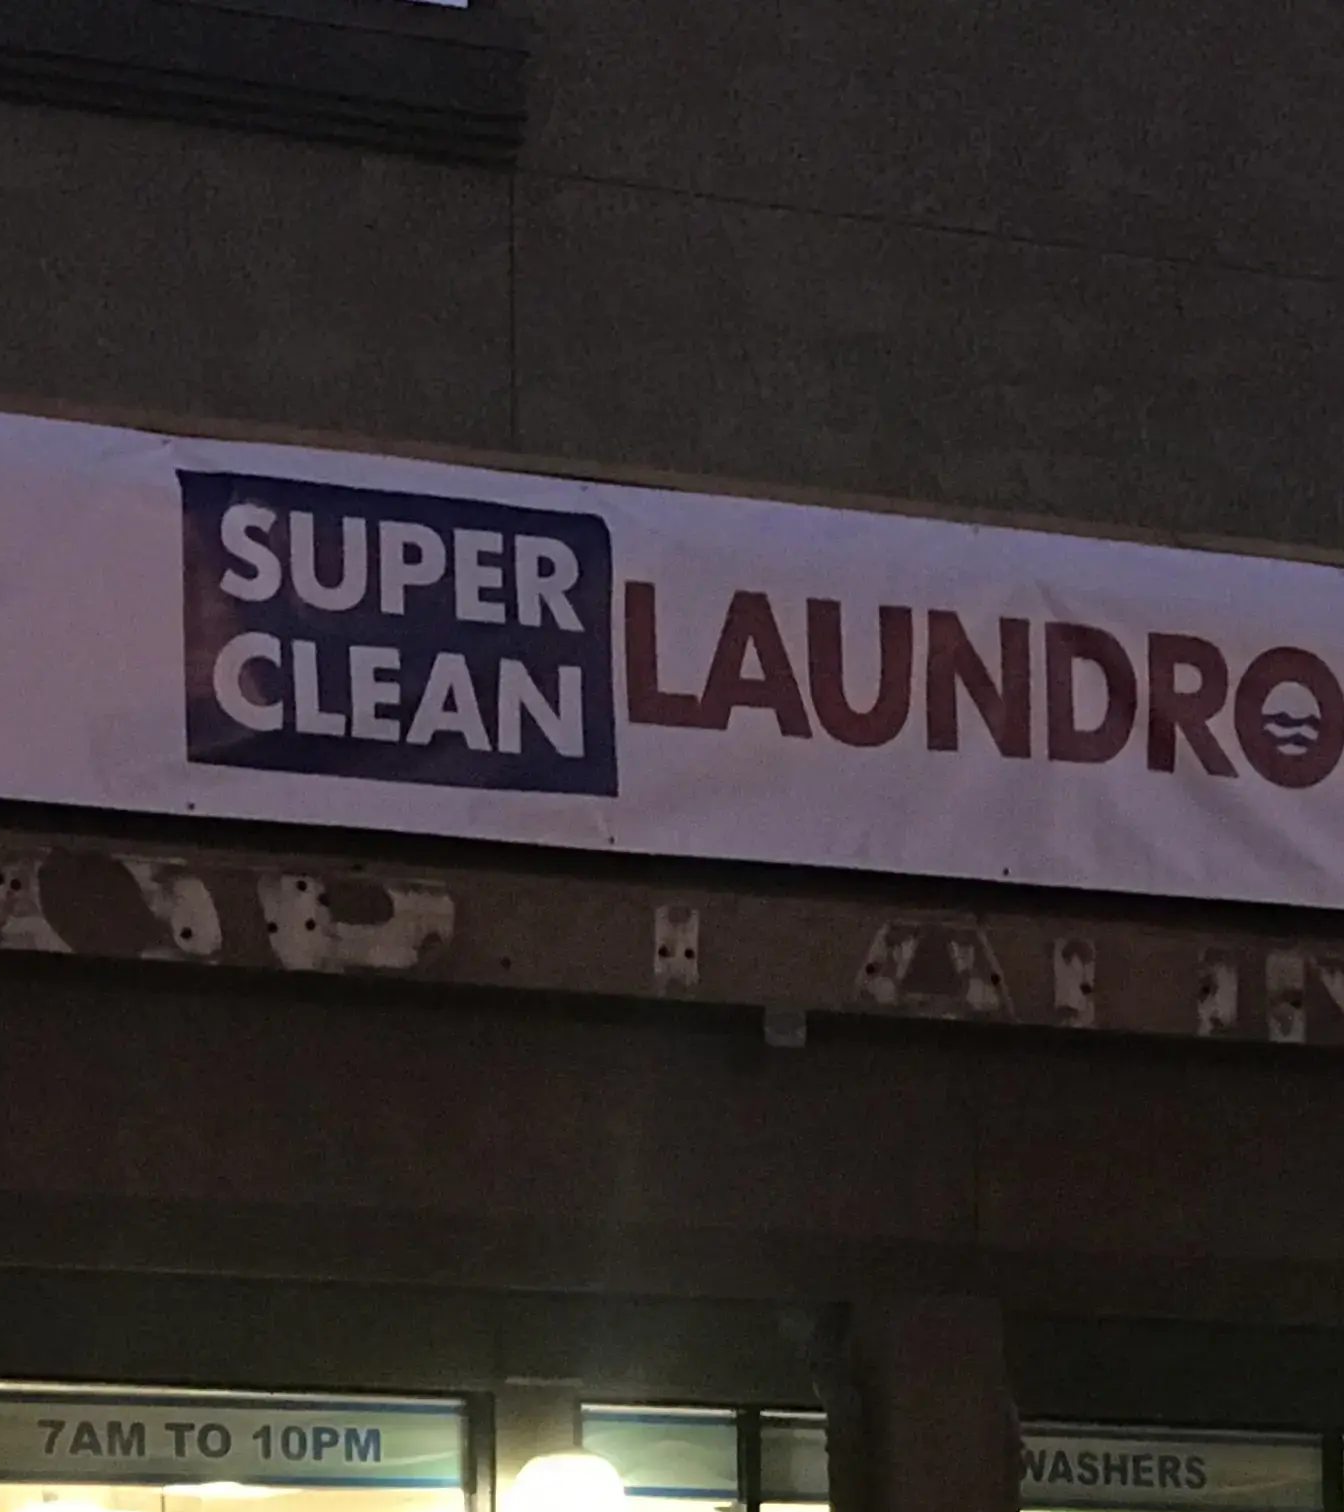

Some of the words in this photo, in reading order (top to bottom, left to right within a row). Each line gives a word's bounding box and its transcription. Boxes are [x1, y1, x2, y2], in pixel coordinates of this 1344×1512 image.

[219, 501, 585, 632] SUPER
[212, 631, 586, 759] CLEAN
[38, 1419, 146, 1457] 7AM
[165, 1421, 231, 1459] TO
[252, 1424, 383, 1463] 10PM
[1020, 1448, 1208, 1490] WASHERS
